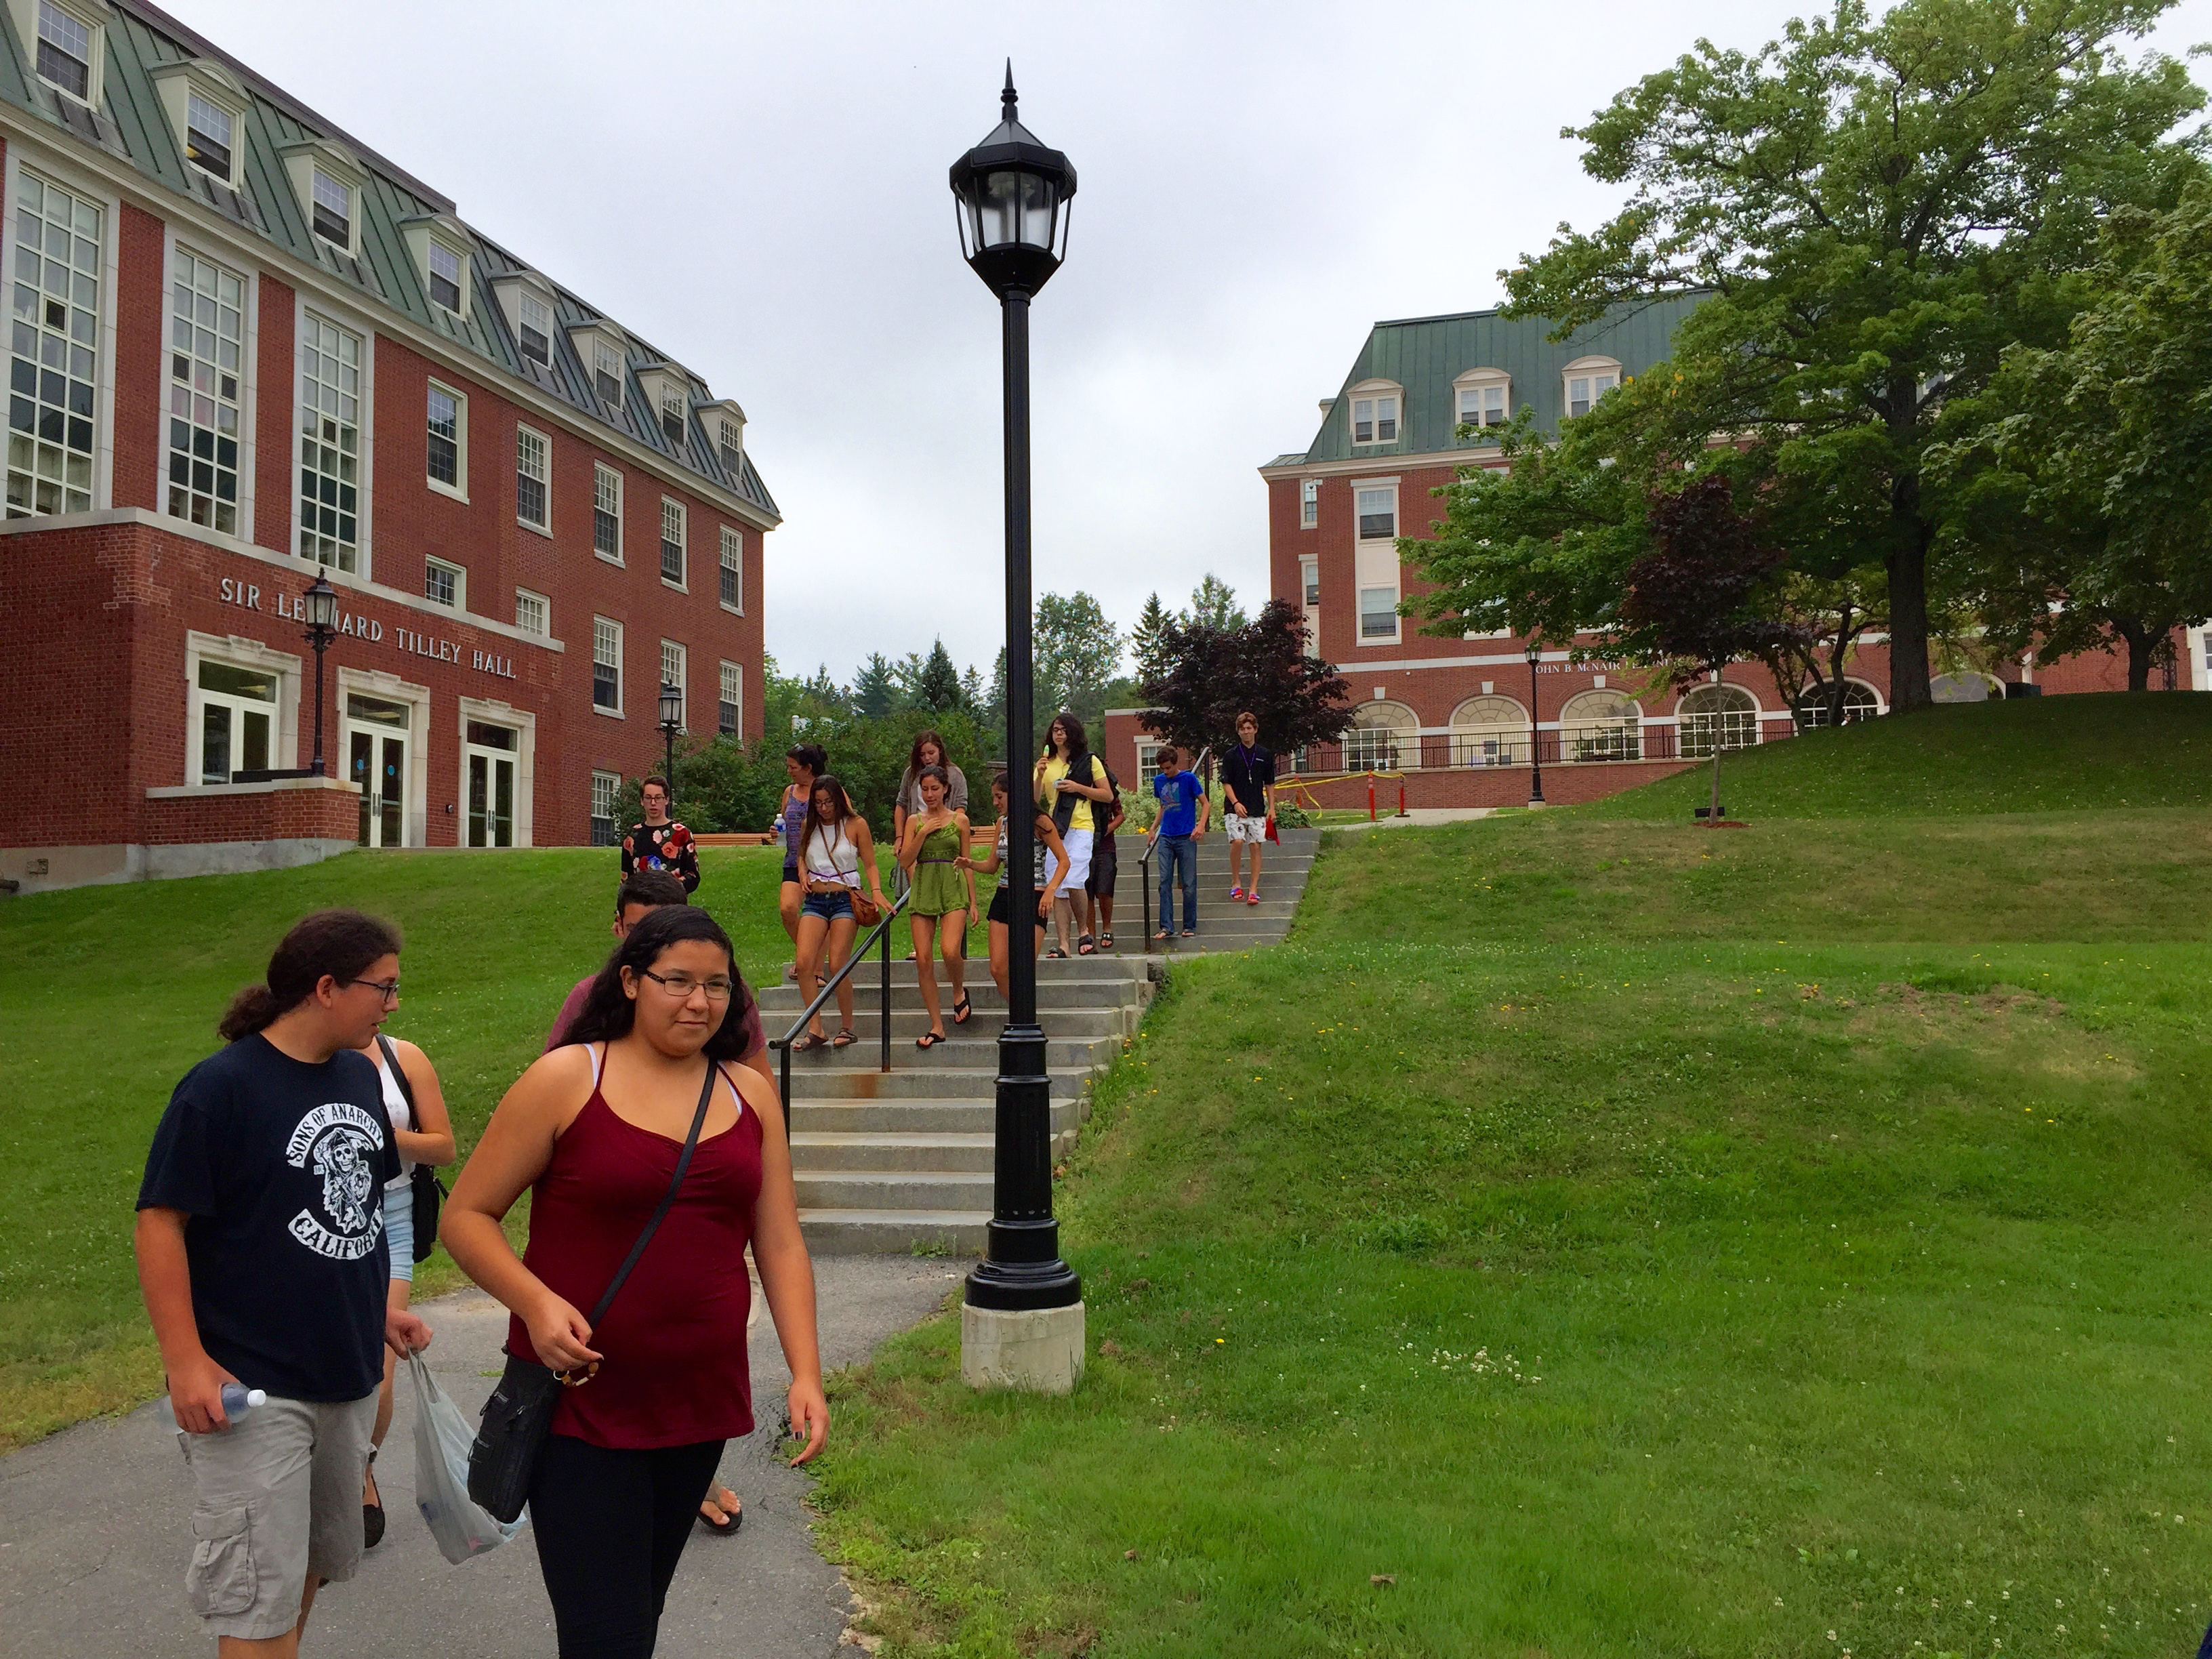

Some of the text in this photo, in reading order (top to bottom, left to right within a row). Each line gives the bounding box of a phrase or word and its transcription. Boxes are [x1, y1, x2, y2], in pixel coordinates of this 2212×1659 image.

[220, 578, 516, 678] SIR LEARD TILLEY HALL
[1529, 664, 1560, 675] OHN
[1564, 664, 1574, 673] B.
[289, 1105, 383, 1162] SONS OF ANARCHY
